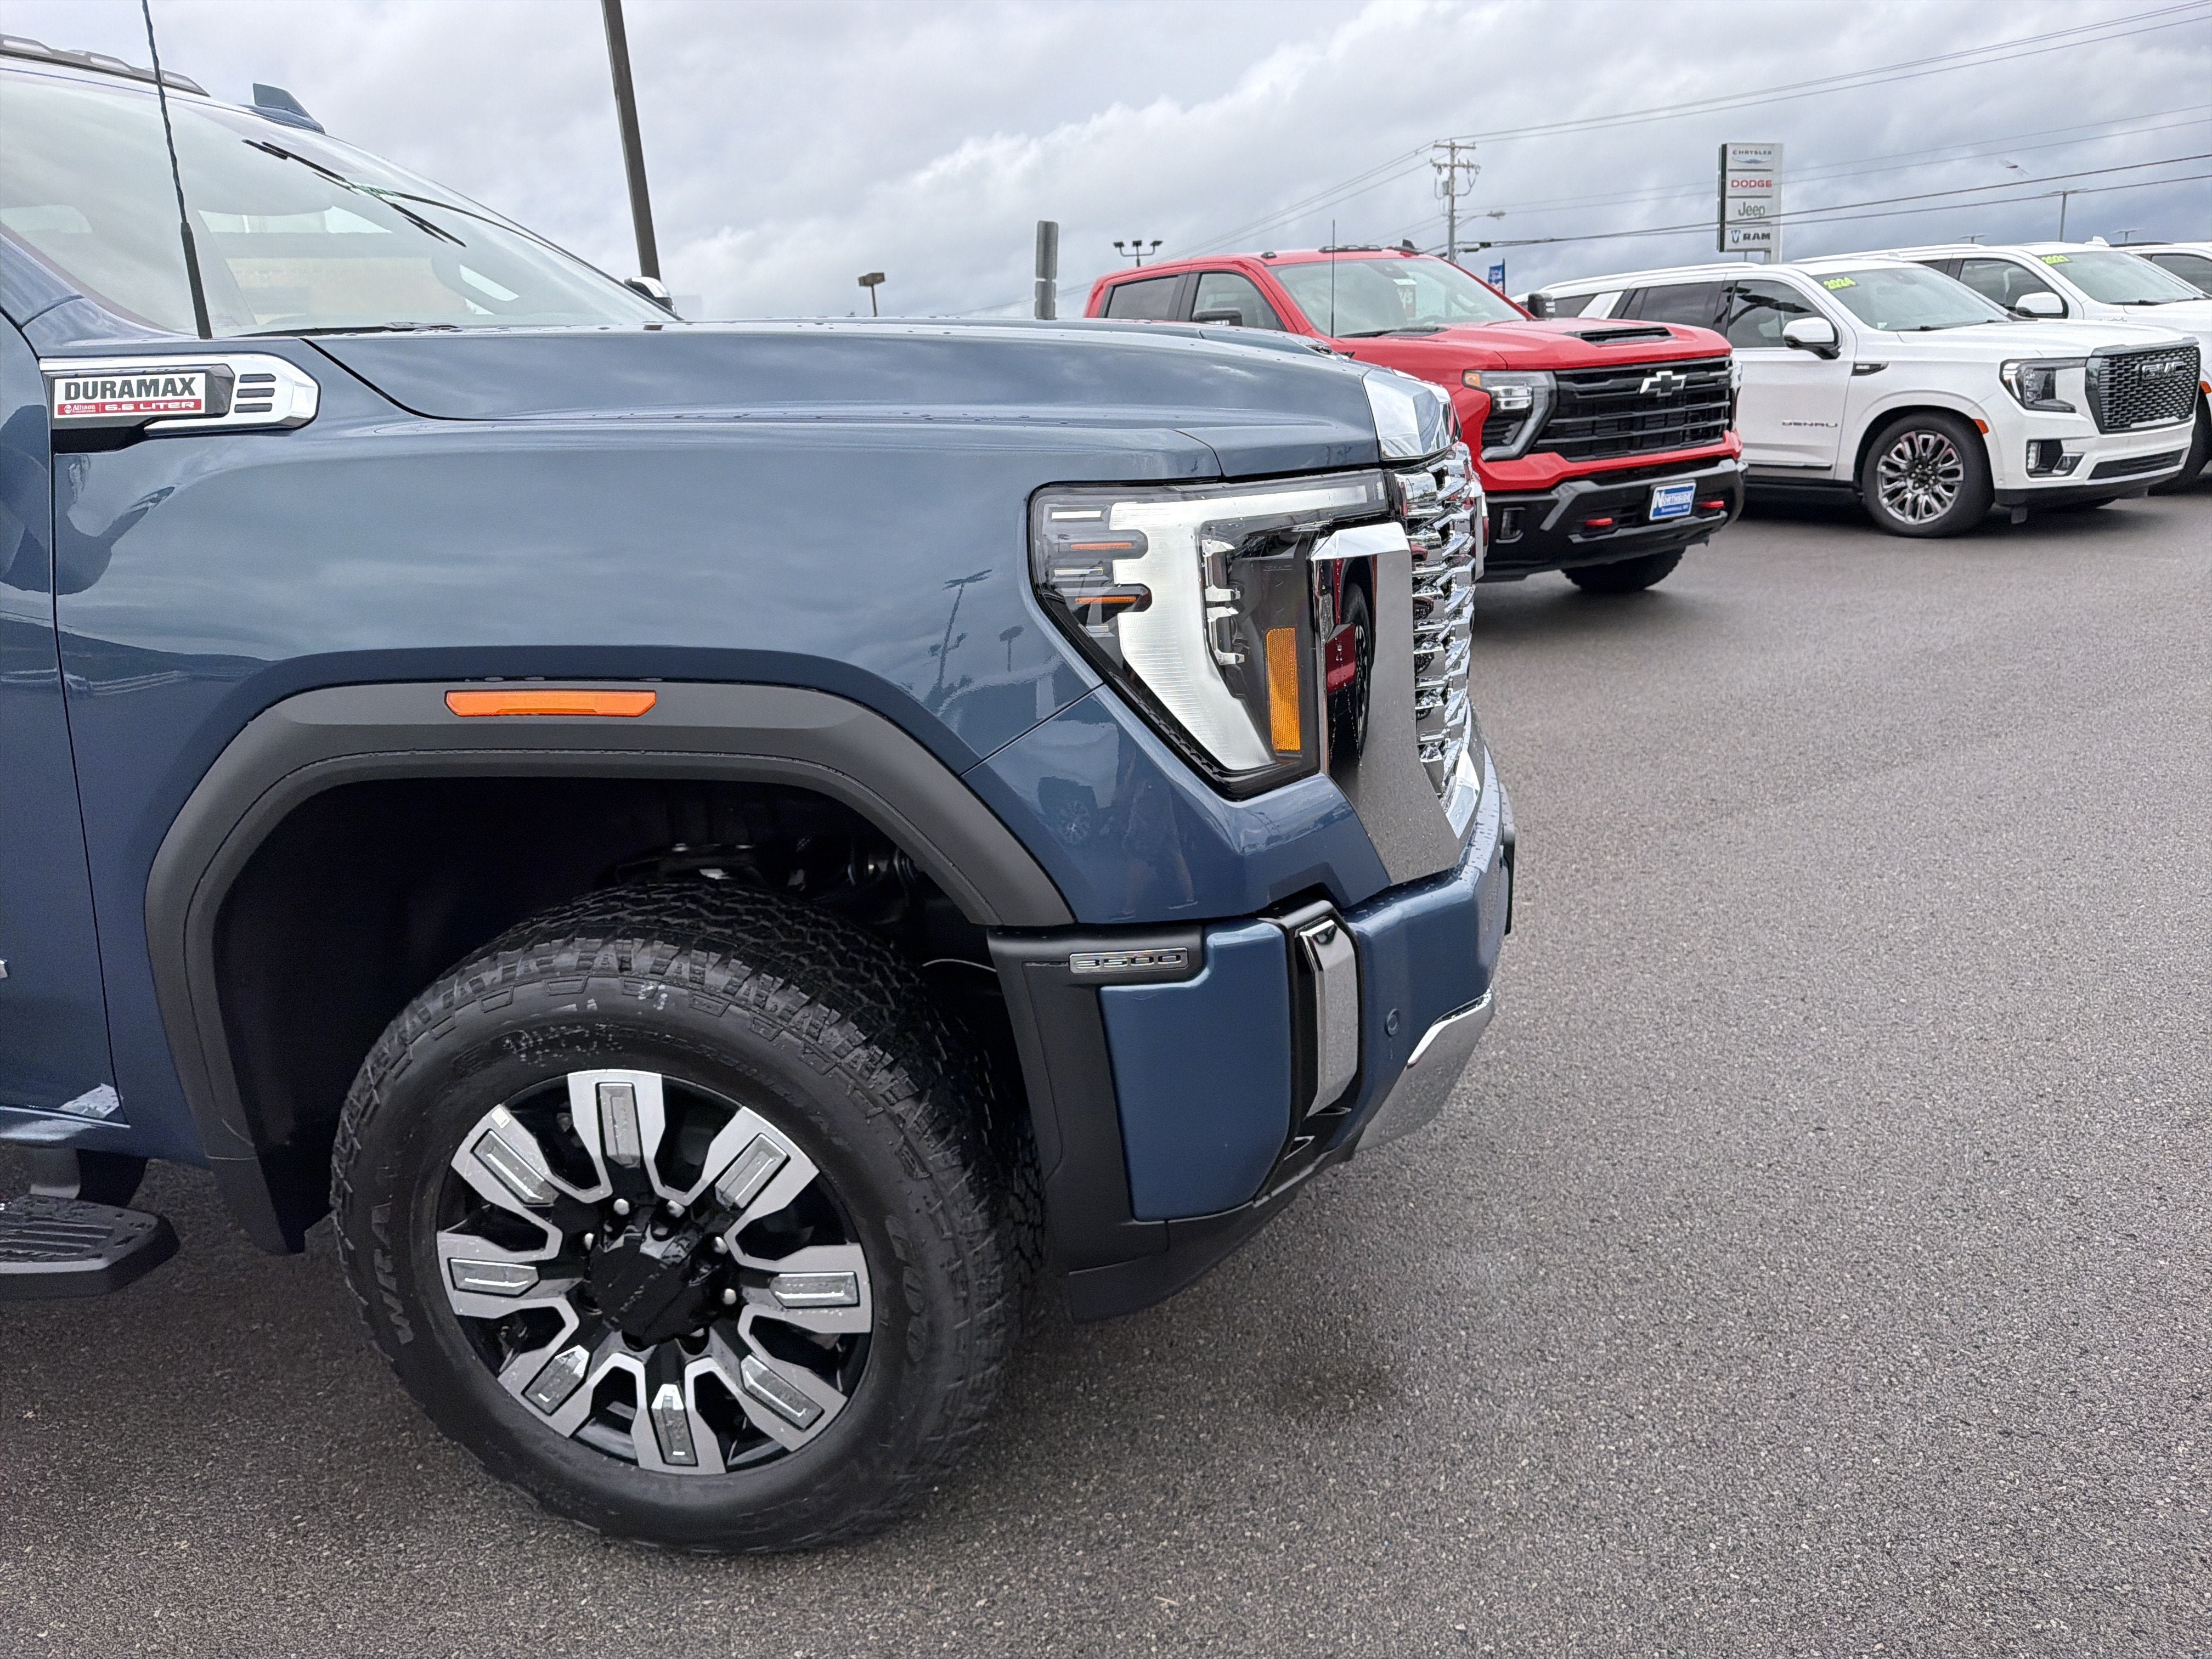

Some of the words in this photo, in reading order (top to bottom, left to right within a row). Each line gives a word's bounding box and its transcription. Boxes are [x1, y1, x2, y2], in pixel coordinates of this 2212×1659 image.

[1731, 179, 1772, 188] DODGE
[1738, 201, 1765, 217] Jeep
[1823, 276, 1857, 290] 2024
[2142, 362, 2188, 380] GMC
[64, 376, 196, 401] DURAMAX
[139, 401, 195, 410] LITER
